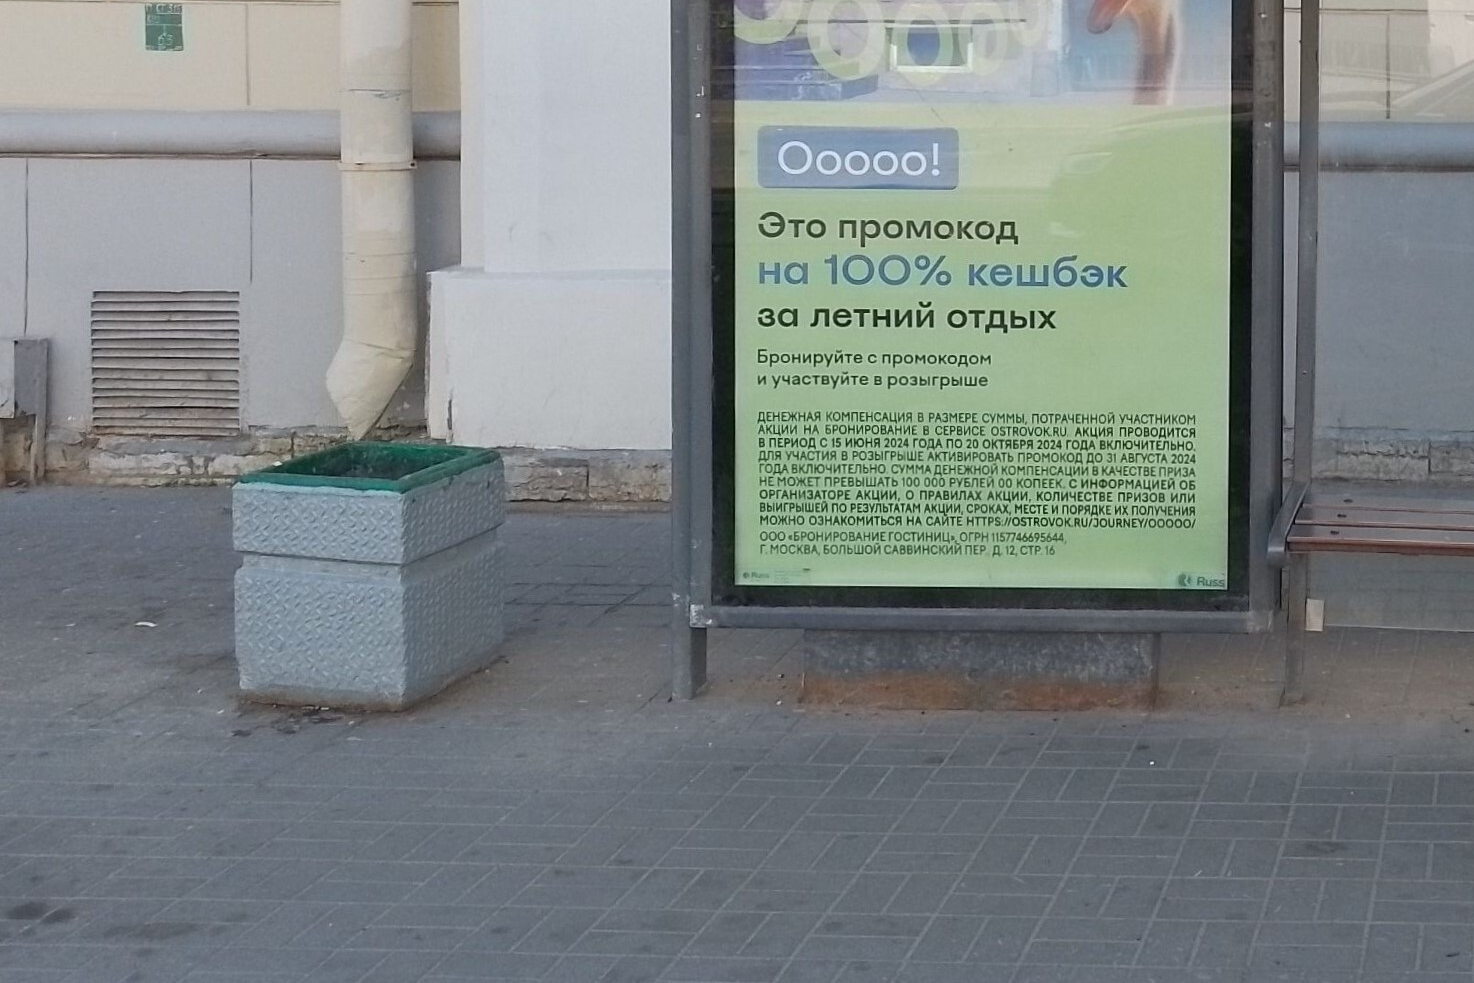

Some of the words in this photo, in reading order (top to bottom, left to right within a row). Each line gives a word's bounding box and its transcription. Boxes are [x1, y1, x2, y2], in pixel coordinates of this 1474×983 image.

[758, 212, 826, 238] Это
[839, 220, 1019, 248] промокод
[759, 262, 809, 285] на
[824, 255, 952, 286] 100%
[968, 255, 1128, 287] кешбэк
[757, 307, 798, 327] за
[809, 300, 935, 328] летний
[947, 310, 1057, 334] отдых
[757, 349, 863, 368] Бронируйте
[867, 353, 877, 364] с
[882, 354, 992, 369] промокодом
[757, 375, 767, 385] и
[771, 371, 869, 390] участвуйте
[873, 375, 883, 386] в
[887, 376, 989, 390] розыгрыше
[757, 411, 821, 423] ДЕНЕЖНАЯ
[825, 411, 913, 423] КОМПЕНСАЦИЯ
[917, 412, 925, 423] В
[928, 412, 978, 423] РАЗМЕРЕ
[981, 413, 1028, 425] СУММЫ,
[1031, 412, 1115, 424] ПОТРАЧЕННОЙ
[1118, 414, 1196, 425] УЧАСТНИКОМ
[758, 424, 798, 436] АКЦИИ
[803, 424, 820, 435] НА
[825, 424, 917, 435] БРОНИРОВАНИЕ
[922, 425, 930, 436] В
[934, 425, 986, 436] СЕРВИСЕ
[1074, 427, 1114, 438] АКЦИЯ
[1119, 427, 1196, 439] ПРОВОДИТСЯ
[758, 437, 766, 448] В
[769, 437, 817, 449] ПЕРИОД
[819, 437, 828, 448] С
[831, 437, 842, 448] 15
[845, 437, 881, 448] ИЮНЯ
[883, 437, 909, 448] 2024
[912, 438, 943, 450] ГОДА
[946, 438, 963, 449] ПО
[966, 439, 979, 449] 20
[982, 439, 1034, 450] ОКТЯБРЯ
[1037, 439, 1062, 450] 2024
[1065, 439, 1096, 451] ГОДА
[758, 450, 782, 462] ДЛЯ
[785, 450, 837, 461] УЧАСТИЯ
[841, 450, 849, 461] В
[852, 450, 924, 461] РОЗЫГРЫШЕ
[927, 451, 1014, 462] АКТИВИРОВАТЬ
[1017, 452, 1084, 464] ПРОМОКОД
[1086, 452, 1103, 464] ДО
[1106, 453, 1117, 463] 31
[1120, 452, 1168, 464] АВГУСТА
[1171, 453, 1196, 465] 2024
[759, 463, 789, 475] ГОДА
[890, 464, 932, 474] СУММА
[933, 463, 999, 476] ДЕНЕЖНОЙ
[1001, 465, 1089, 477] КОМПЕНСАЦИИ
[1092, 466, 1099, 476] В
[1101, 466, 1156, 477] КАЧЕСТВЕ
[1158, 467, 1196, 478] ПРИЗА
[759, 476, 775, 487] НЕ
[777, 476, 821, 487] МОЖЕТ
[824, 476, 899, 487] ПРЕВЫШАТЬ
[902, 477, 921, 487] 100
[923, 477, 946, 488] 000
[949, 476, 995, 488] РУБЛЕЙ
[998, 478, 1013, 488] 00
[1068, 478, 1077, 489] С
[1080, 478, 1176, 491] ИНФОРМАЦИЕЙ
[1179, 480, 1196, 491] ОБ
[759, 489, 850, 500] ОРГАНИЗАТОРЕ
[856, 490, 900, 502] АКЦИИ,
[905, 490, 914, 500] О
[919, 490, 982, 501] ПРАВИЛАХ
[987, 491, 1031, 503] АКЦИИ,
[1036, 491, 1113, 502] КОЛИЧЕСТВЕ
[1118, 492, 1165, 503] ПРИЗОВ
[1171, 493, 1195, 503] ИЛИ
[759, 501, 828, 513] ВЫИГРЫШЕЙ
[831, 503, 847, 513] ПО
[850, 503, 921, 514] РЕЗУЛЬТАТАМ
[924, 503, 963, 515] АКЦИИ,
[966, 503, 1011, 515] СРОКАХ,
[1014, 504, 1048, 515] МЕСТЕ
[1051, 505, 1059, 514] И
[1062, 504, 1111, 516] ПОРЯДКЕ
[1114, 505, 1129, 516] ИХ
[1131, 506, 1196, 516] ПОЛУЧЕНИЯ
[759, 515, 805, 526] МОЖНО
[808, 515, 903, 526] ОЗНАКОМИТЬСЯ
[906, 516, 922, 526] НА
[925, 515, 963, 527] САЙТЕ
[760, 531, 786, 542] ООО
[959, 531, 989, 542] ОГРН
[770, 544, 821, 555] МОСКВА,
[823, 542, 882, 555] БОЛЬШОЙ
[883, 543, 962, 555] САВВИНСКИЙ
[1005, 545, 1018, 557] 12,
[1045, 545, 1056, 555] 16
[1196, 576, 1225, 588] Russ
